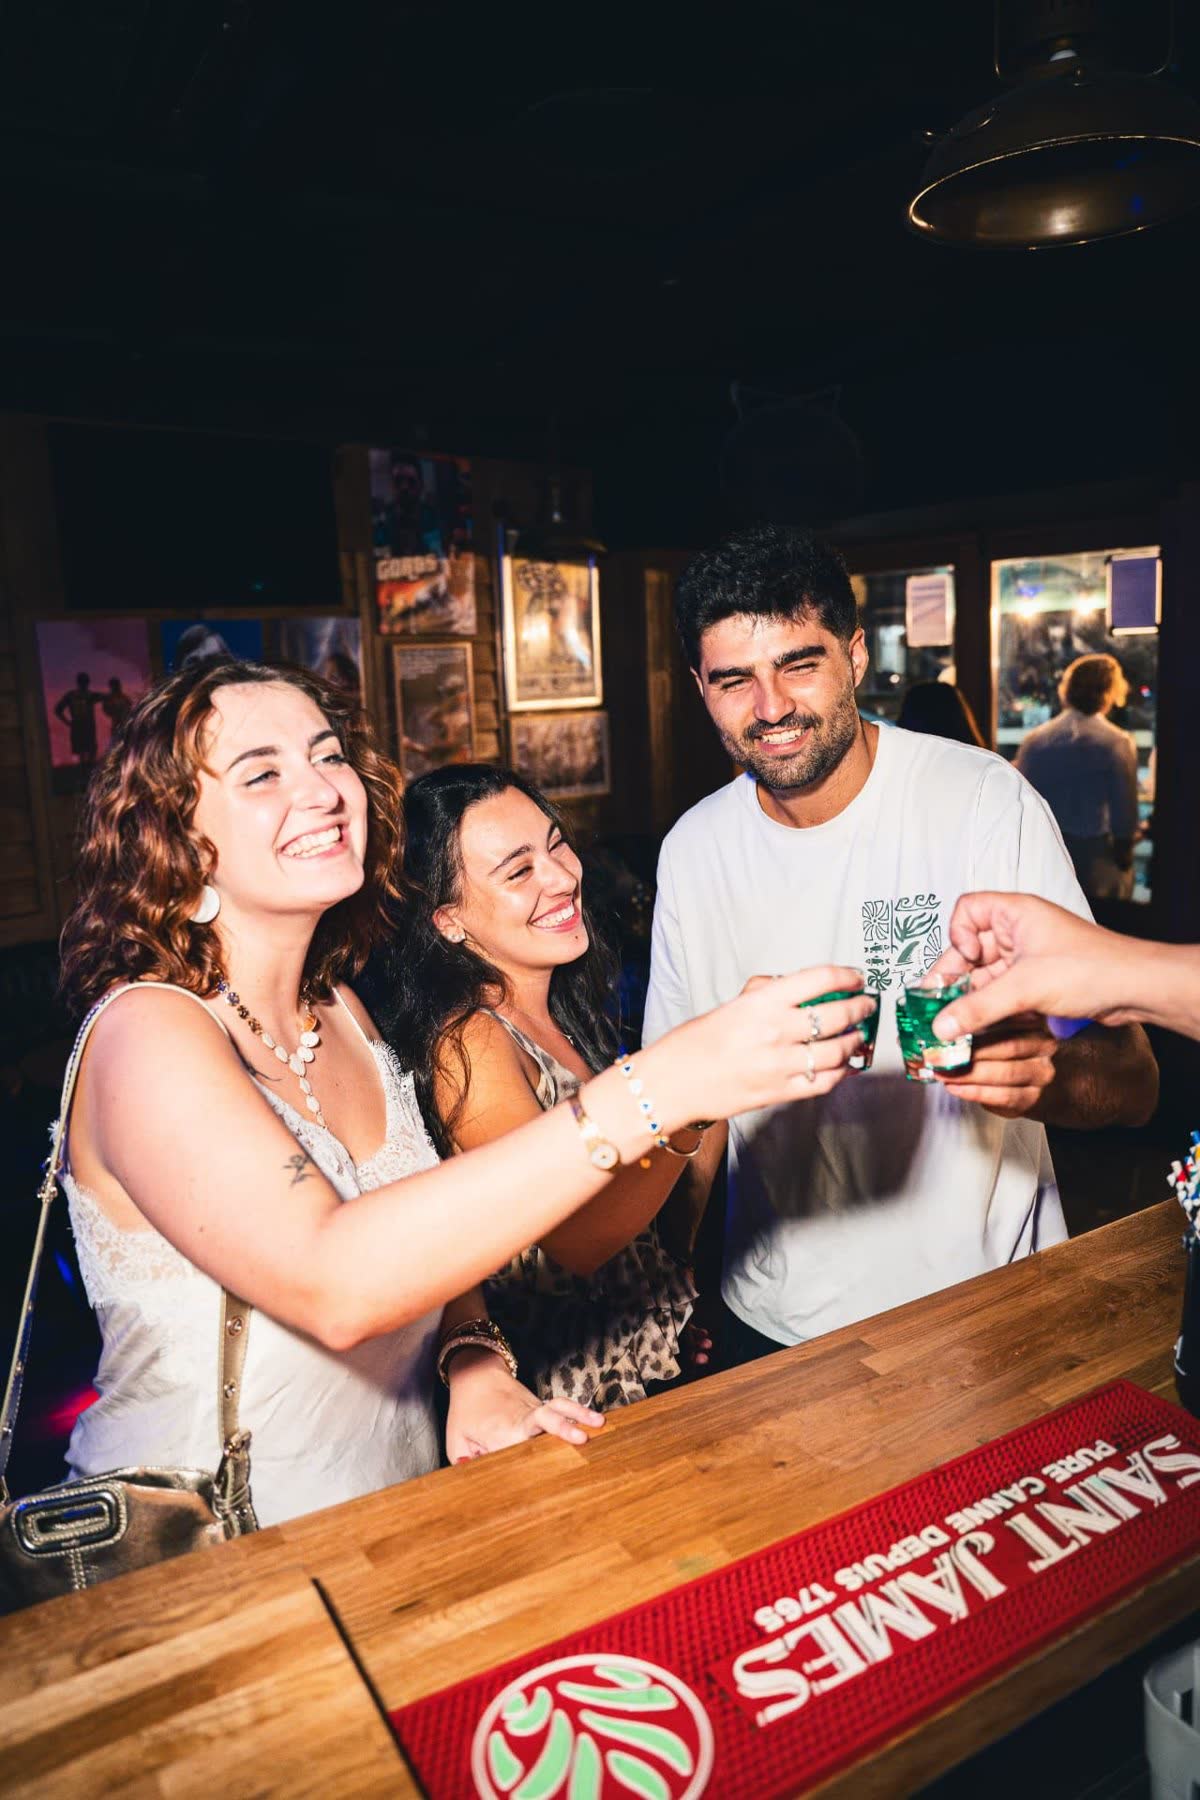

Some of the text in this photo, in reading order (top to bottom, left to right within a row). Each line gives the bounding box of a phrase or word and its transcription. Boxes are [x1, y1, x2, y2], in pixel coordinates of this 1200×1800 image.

[732, 1433, 1200, 1727] SAINT JAMES
[754, 1439, 1118, 1633] PURE CANNE DEPUIS 1765
